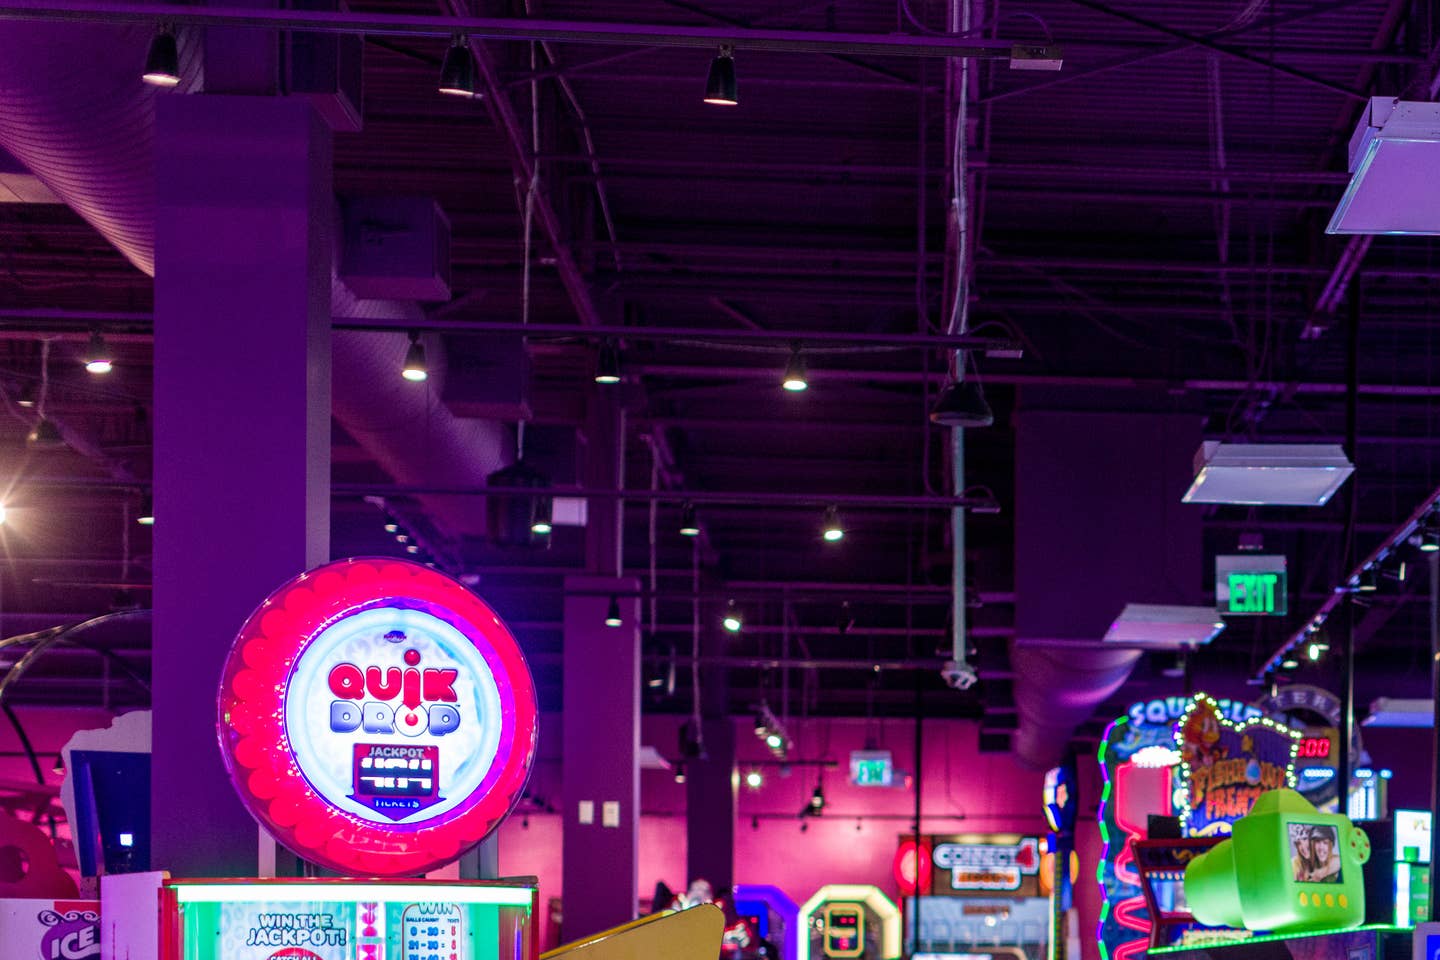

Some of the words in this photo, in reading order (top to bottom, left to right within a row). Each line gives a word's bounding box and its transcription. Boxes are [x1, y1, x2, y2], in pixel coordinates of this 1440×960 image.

[1228, 574, 1278, 612] EXIT
[328, 649, 458, 702] QUIK
[330, 700, 461, 737] DROP
[369, 746, 424, 758] JACKPOT
[258, 914, 294, 928] WIN
[296, 914, 333, 928] THE
[418, 902, 454, 914] WIN
[52, 924, 100, 960] ICE
[246, 928, 347, 946] JACKPOT!
